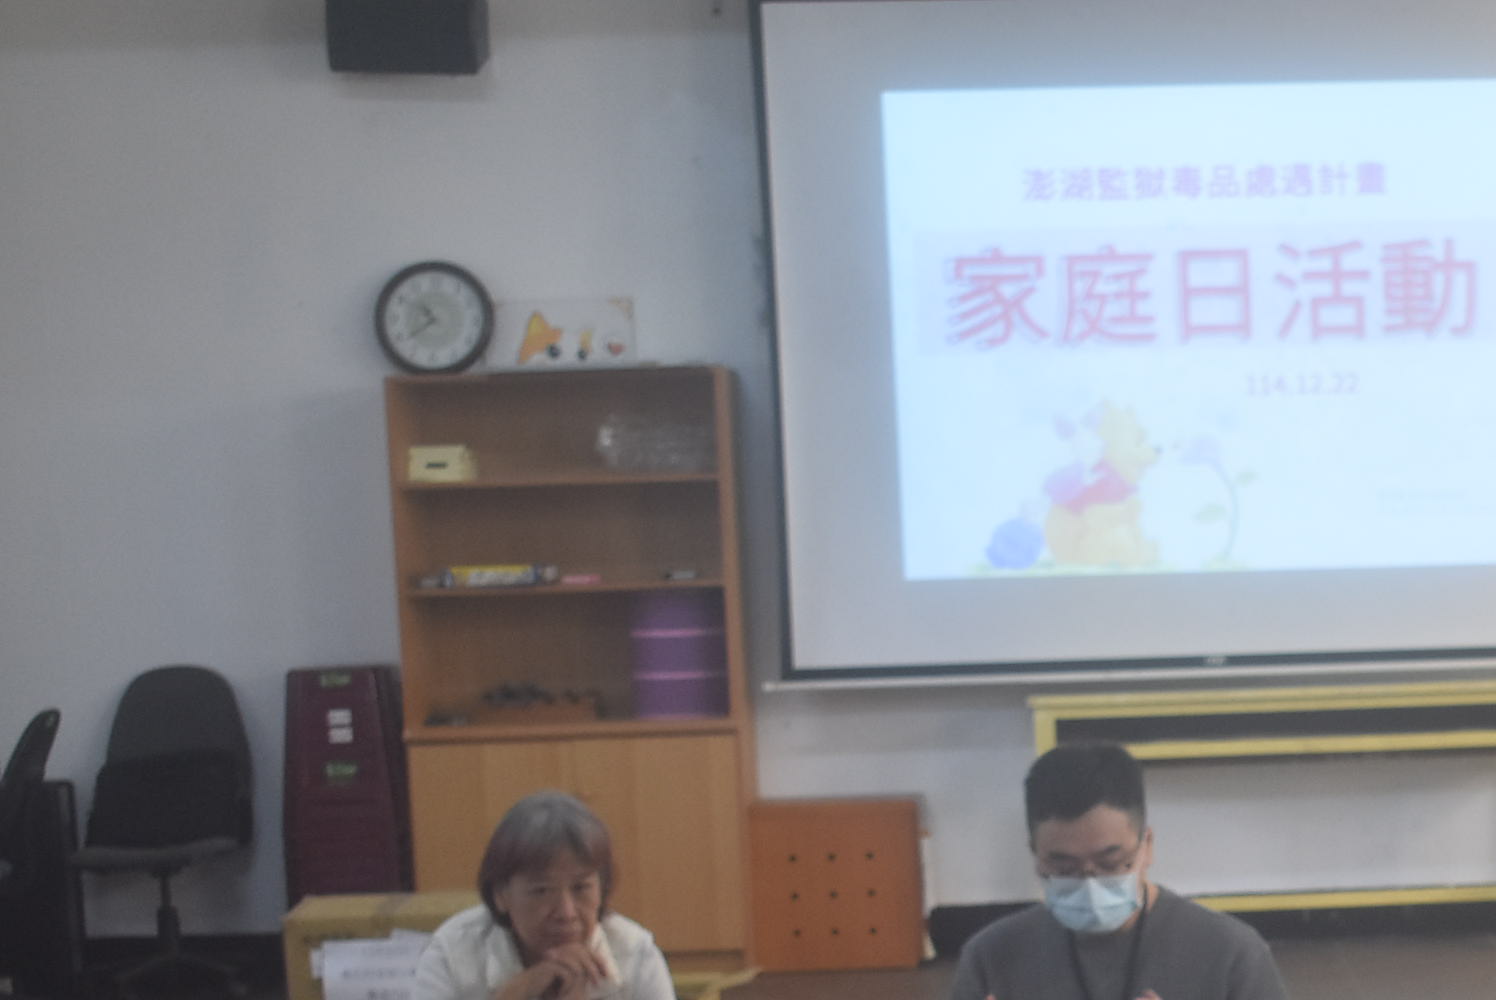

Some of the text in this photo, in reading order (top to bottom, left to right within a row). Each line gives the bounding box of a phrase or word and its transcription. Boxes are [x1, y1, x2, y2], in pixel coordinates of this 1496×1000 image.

[945, 238, 1480, 348] 家庭日活動
